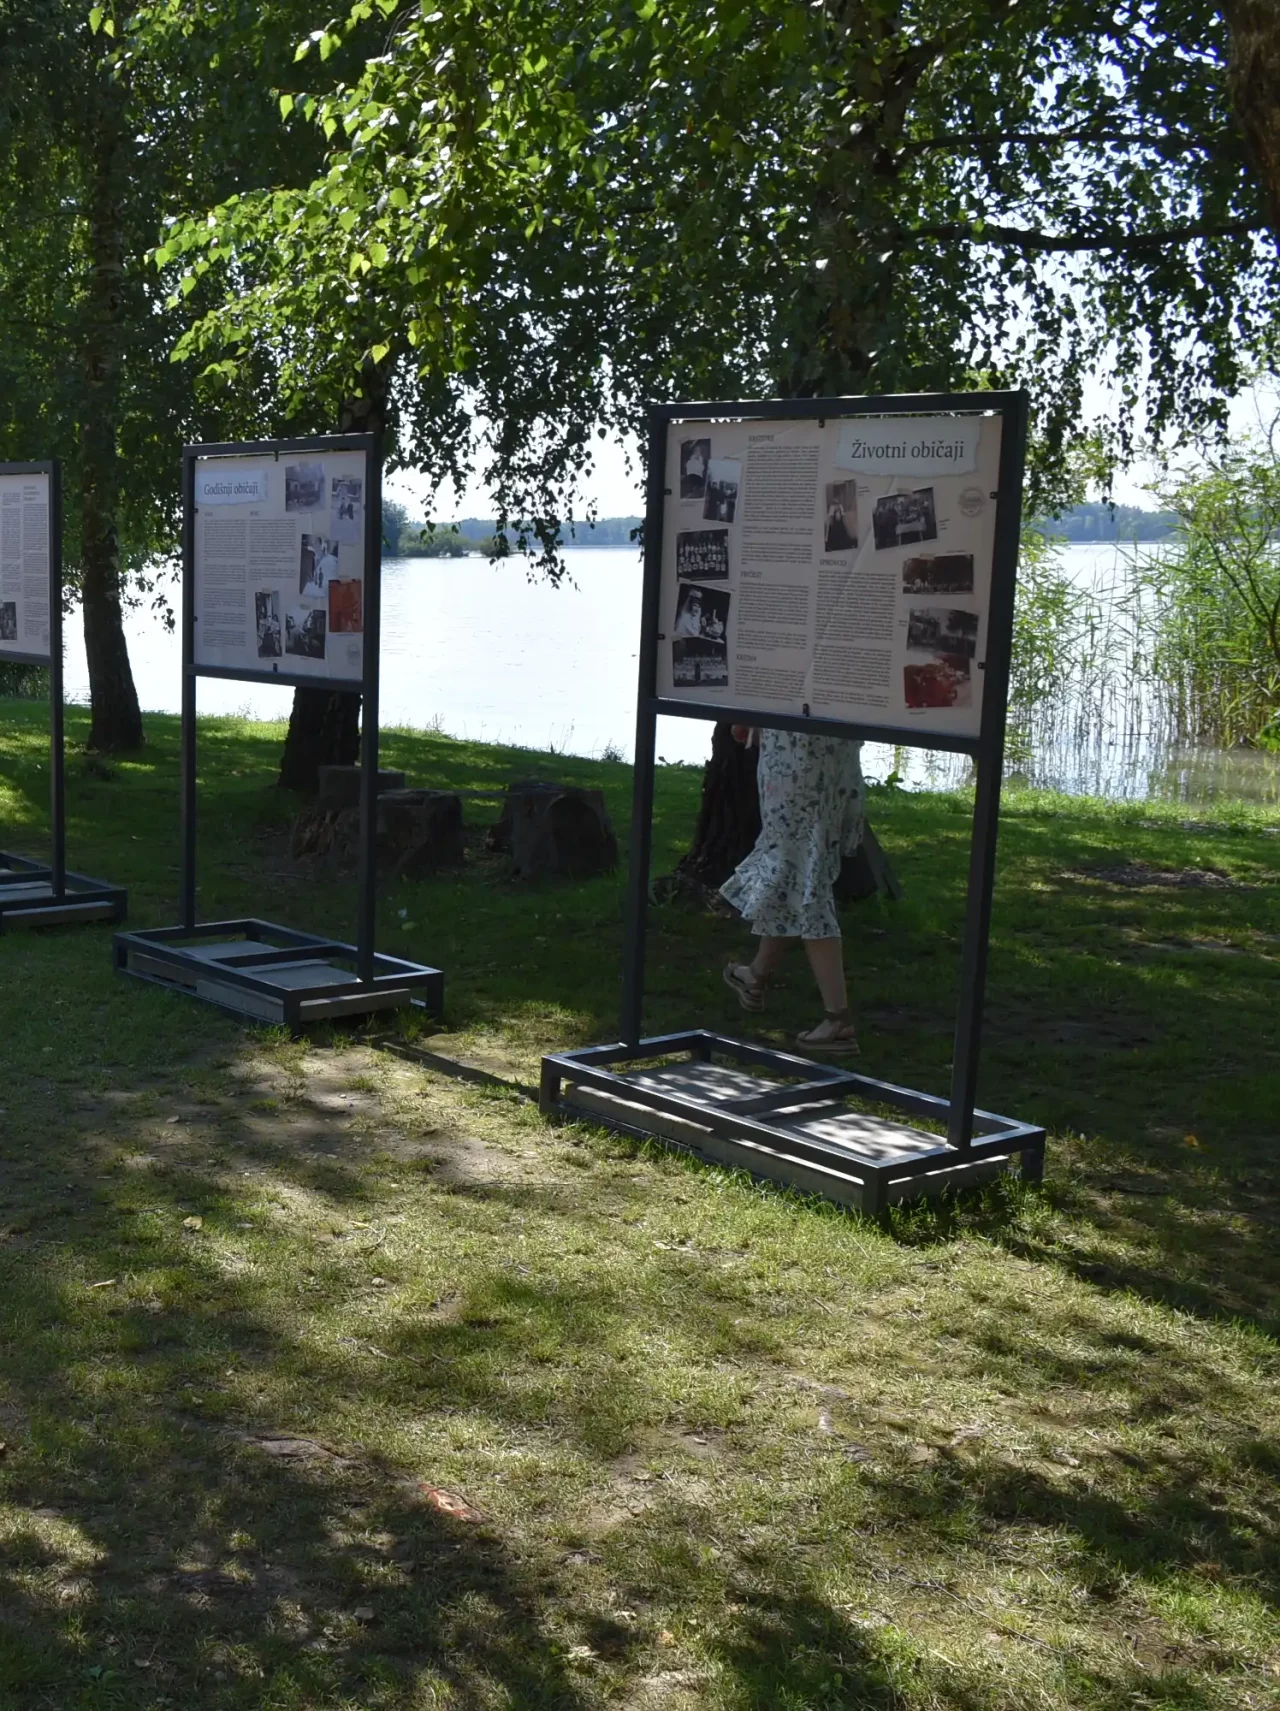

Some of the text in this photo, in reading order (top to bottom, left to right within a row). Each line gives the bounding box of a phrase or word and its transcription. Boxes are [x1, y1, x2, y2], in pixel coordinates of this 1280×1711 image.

[851, 438, 965, 462] Životni običaji
[203, 480, 258, 497] Godišnji običaji
